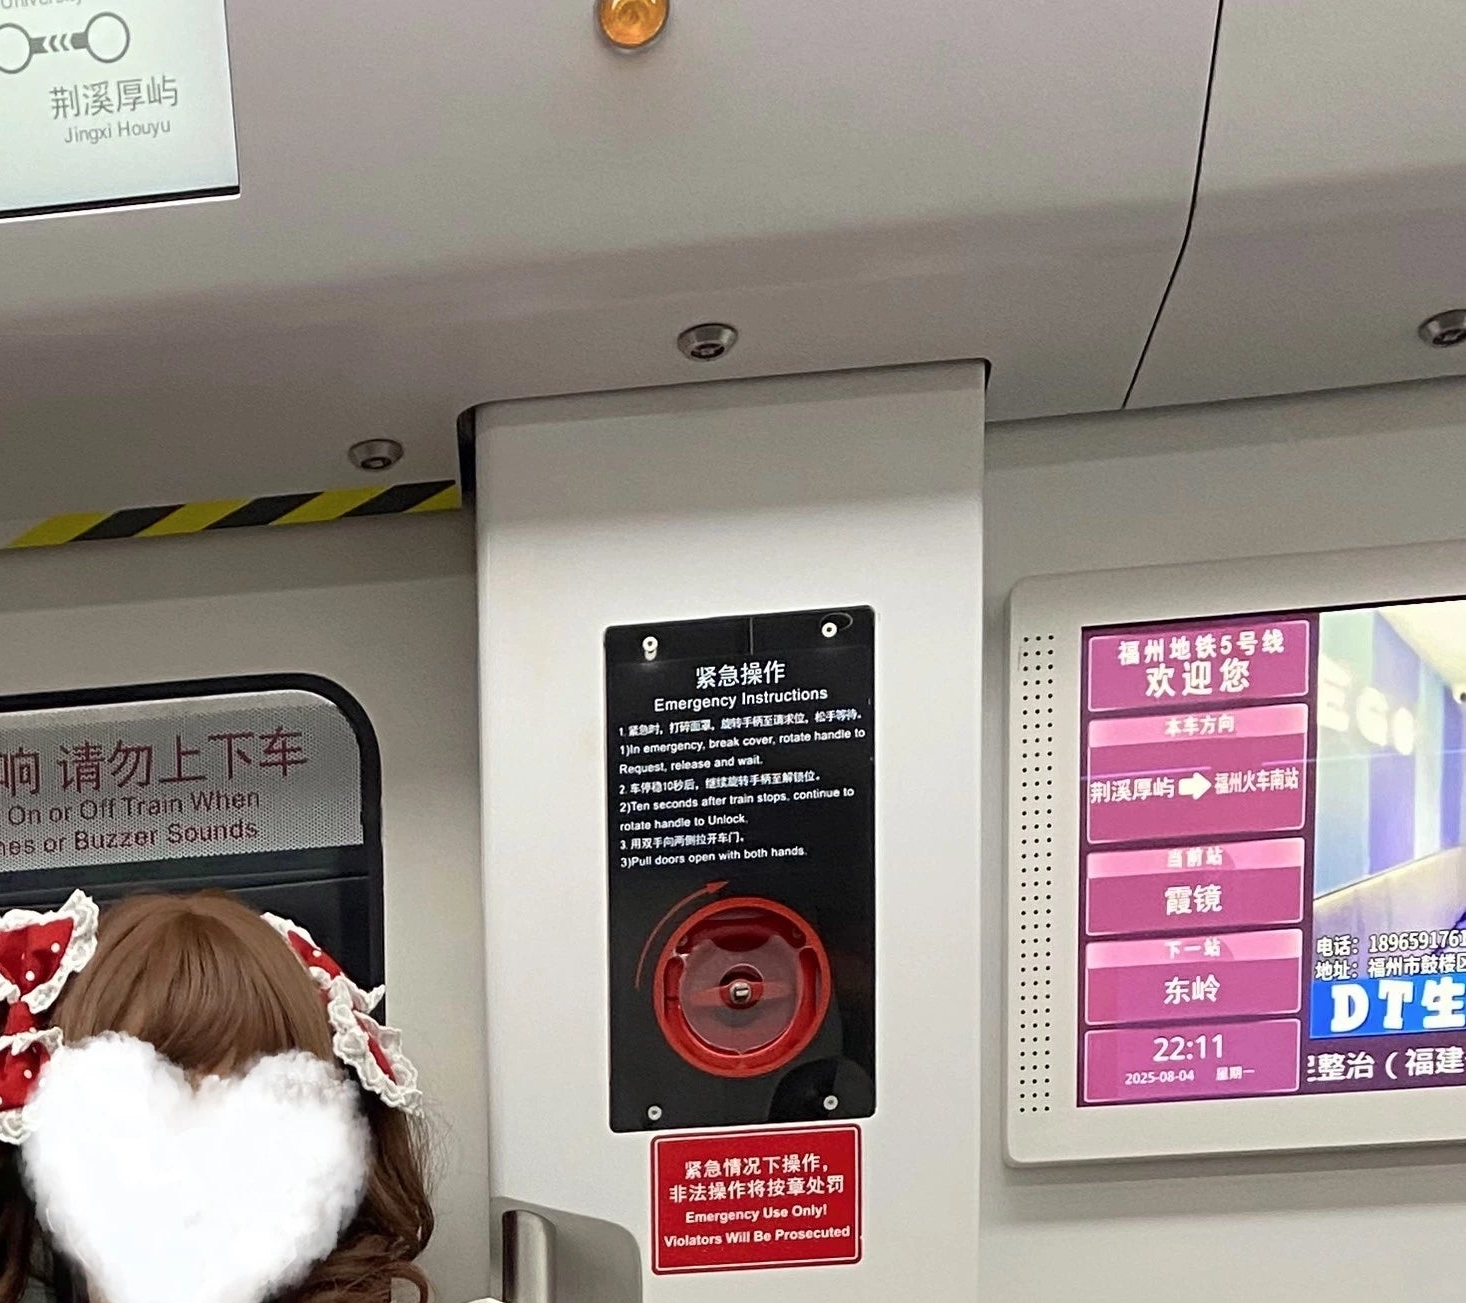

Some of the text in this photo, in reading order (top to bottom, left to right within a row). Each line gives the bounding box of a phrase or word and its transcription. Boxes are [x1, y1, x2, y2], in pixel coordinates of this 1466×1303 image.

[49, 75, 179, 121] 荆溪厚屿
[63, 119, 172, 146] Jingxi Houyu
[1118, 629, 1285, 666] 福州地铁5号线
[696, 660, 785, 689] 紧急操作
[1145, 657, 1250, 698] 欢迎您
[654, 687, 828, 712] Emergency Instructions
[1165, 713, 1235, 736] 本车方向
[709, 737, 740, 749] break
[743, 735, 776, 747] cover,
[779, 732, 811, 744] rotate
[814, 729, 851, 741] handle
[854, 728, 866, 738] to
[57, 727, 309, 793] 请勿上下车
[619, 755, 763, 776] Request, release and wait.
[1089, 767, 1299, 803] 荆溪厚屿 福州火车南站
[7, 804, 43, 826] On
[48, 805, 72, 823] or
[80, 799, 118, 820] Off
[126, 794, 183, 817] Train
[190, 790, 260, 813] When
[619, 801, 650, 814] 2)Ten
[653, 798, 698, 811] seconds
[701, 796, 726, 807] after
[729, 794, 754, 805] train
[793, 789, 840, 801] continue
[843, 787, 855, 797] to
[43, 835, 67, 853] or
[75, 827, 159, 851] Buzzer
[166, 820, 259, 844] Sounds
[620, 820, 652, 832] rotate
[654, 817, 691, 829] handle
[694, 816, 705, 826] to
[620, 855, 652, 868] 3)Pull
[654, 853, 685, 865] doors
[688, 852, 715, 865] open
[718, 849, 741, 860] with
[744, 847, 768, 859] both
[1167, 846, 1224, 869] 当前站
[1164, 883, 1223, 916] 霞镜
[1165, 936, 1221, 960] 下一站
[1317, 935, 1359, 957] 电话：
[1315, 960, 1358, 982] 地址：
[1164, 973, 1221, 1005] 东岭
[1330, 976, 1465, 1032] DT生
[1152, 1033, 1224, 1063] 22:11
[1124, 1065, 1255, 1086] 2025-08-04 星期一
[1307, 1045, 1466, 1083] 整治（福建
[685, 1153, 830, 1180] 紧急情况下操作，
[669, 1174, 845, 1203] 非法操作将按章处罚
[685, 1203, 827, 1224] Emergency Use Only!
[664, 1225, 850, 1248] Violators Will Be Prosecuted
